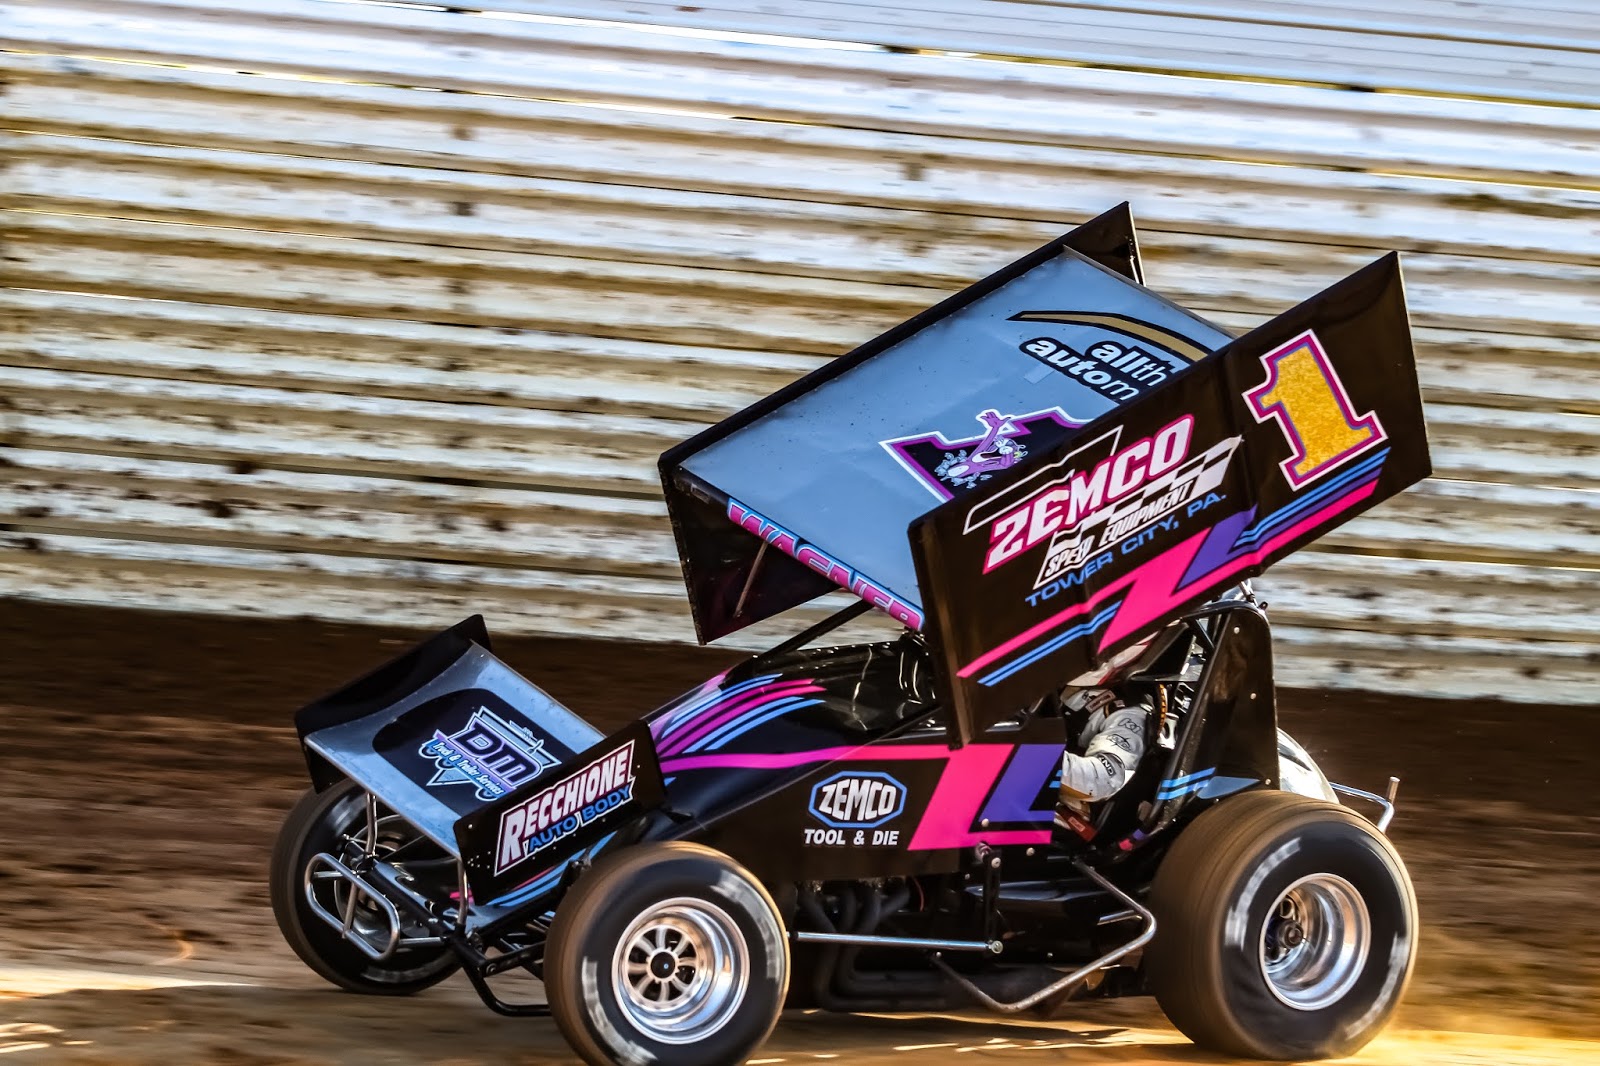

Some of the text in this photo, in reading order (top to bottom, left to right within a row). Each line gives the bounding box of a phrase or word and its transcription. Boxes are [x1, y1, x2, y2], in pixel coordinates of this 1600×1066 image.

[1242, 328, 1389, 492] 1
[983, 415, 1194, 574] ZEMCO
[1099, 480, 1194, 548] EQUIPMENT
[1025, 492, 1227, 607] TOWER CITY, PA.
[433, 742, 454, 755] Truck
[457, 760, 480, 775] Trailer
[500, 750, 629, 867] RECCHIONE
[528, 784, 631, 852] AUTO BODY
[818, 778, 897, 821] ZEMCO
[804, 828, 900, 845] TOOL & DIE
